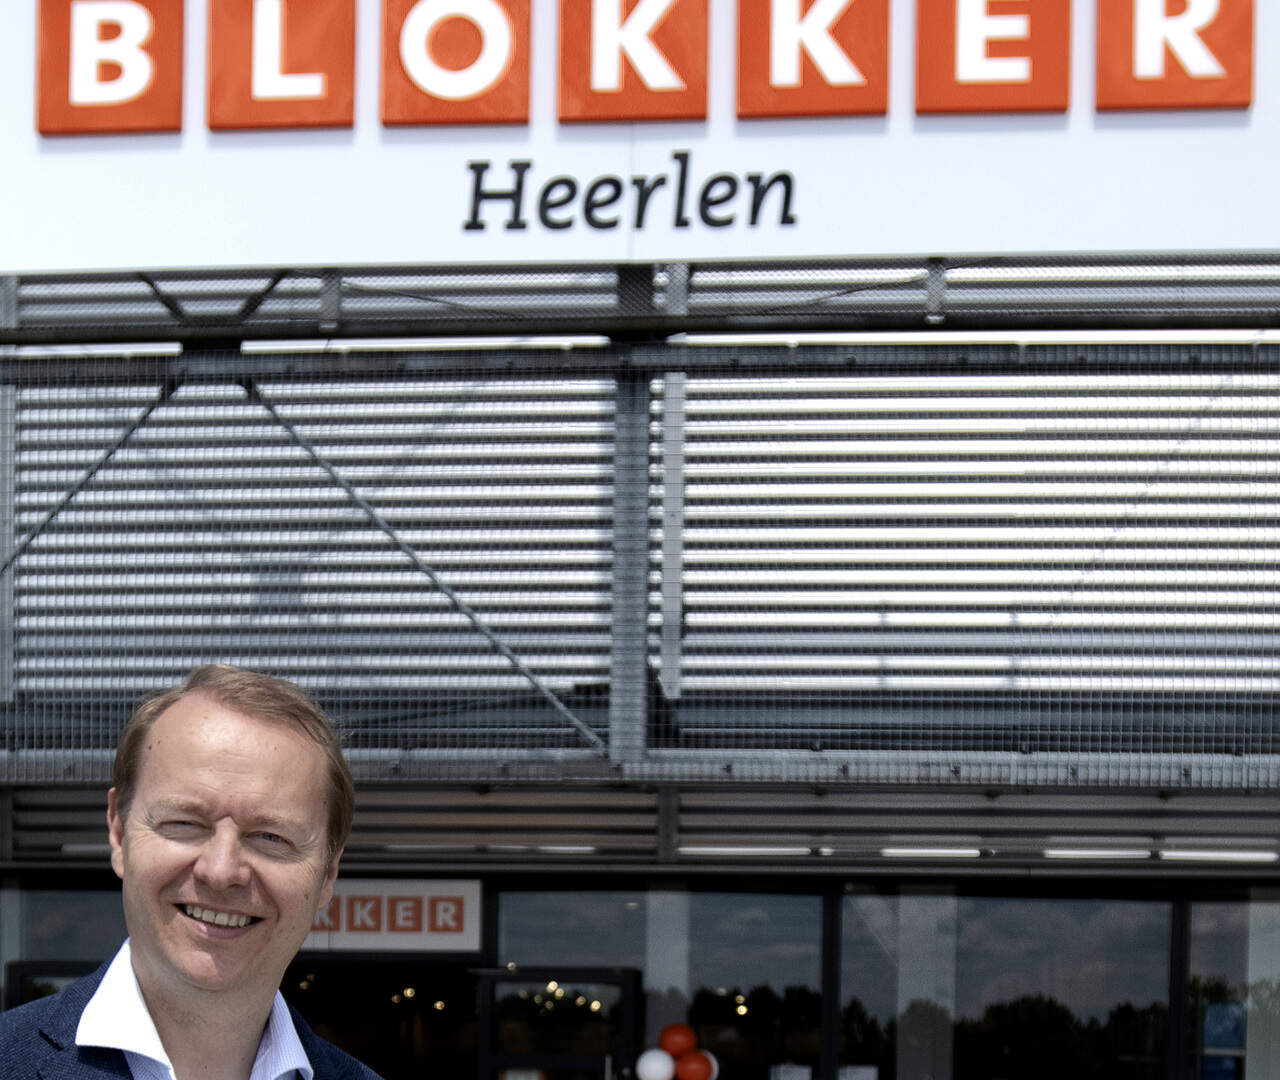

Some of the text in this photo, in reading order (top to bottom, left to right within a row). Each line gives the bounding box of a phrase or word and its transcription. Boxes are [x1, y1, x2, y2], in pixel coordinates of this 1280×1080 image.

[68, 0, 1229, 107] BLOKKER
[462, 151, 798, 231] Heerlen
[313, 901, 458, 928] KKER
